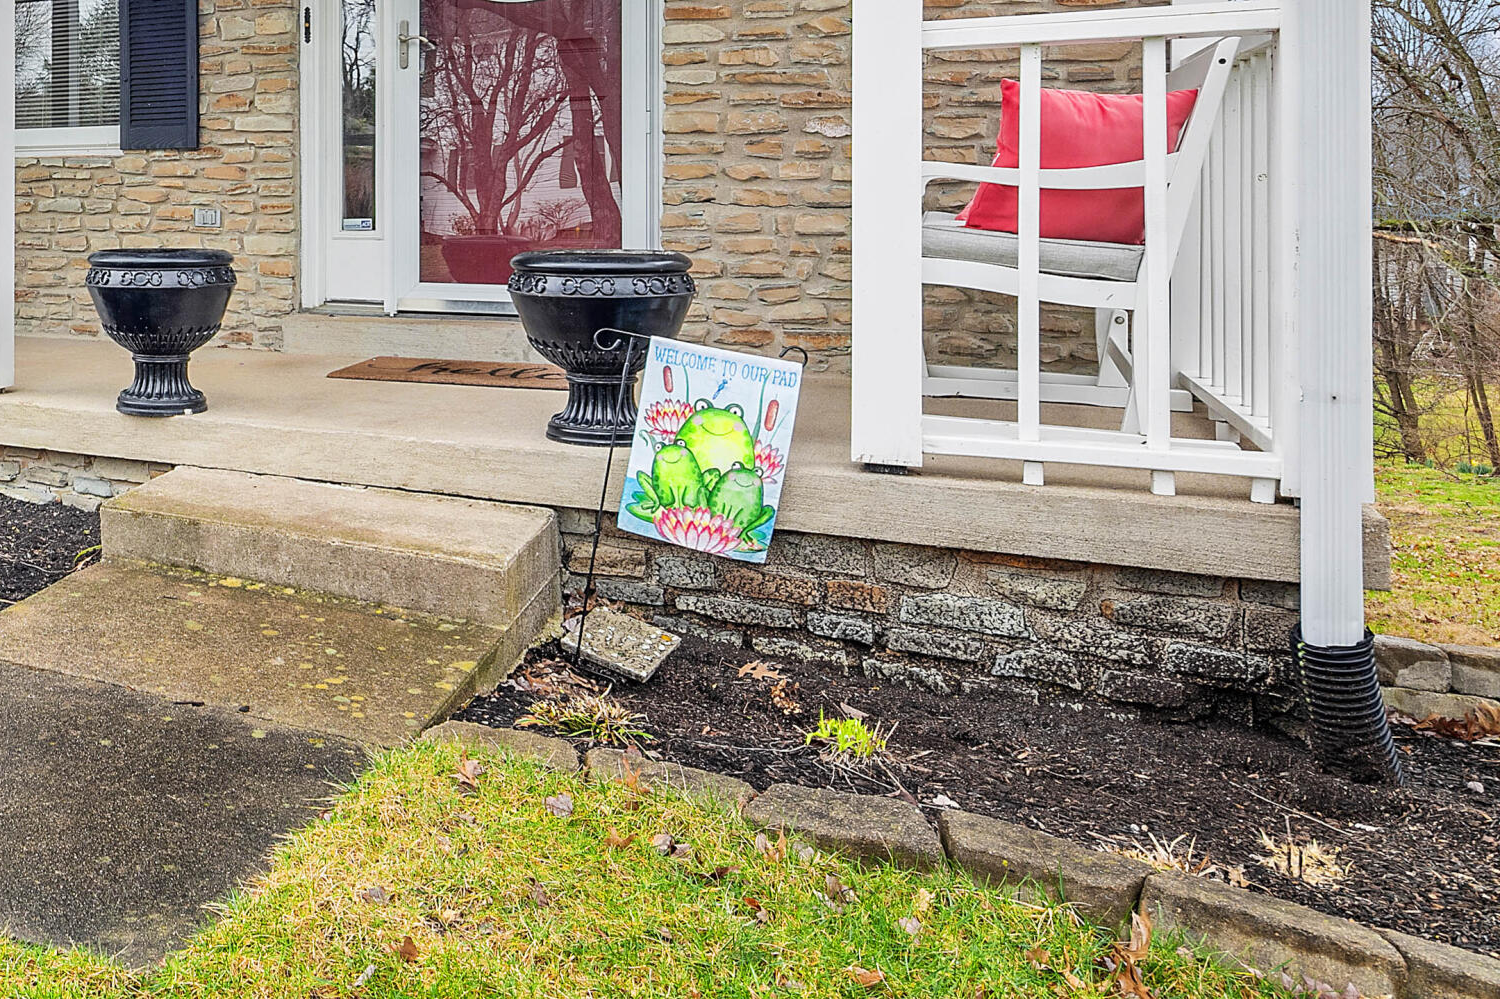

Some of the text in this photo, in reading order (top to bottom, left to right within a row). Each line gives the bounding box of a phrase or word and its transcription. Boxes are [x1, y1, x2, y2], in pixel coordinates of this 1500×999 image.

[655, 346, 798, 388] WELCOME TO OUR PAD
